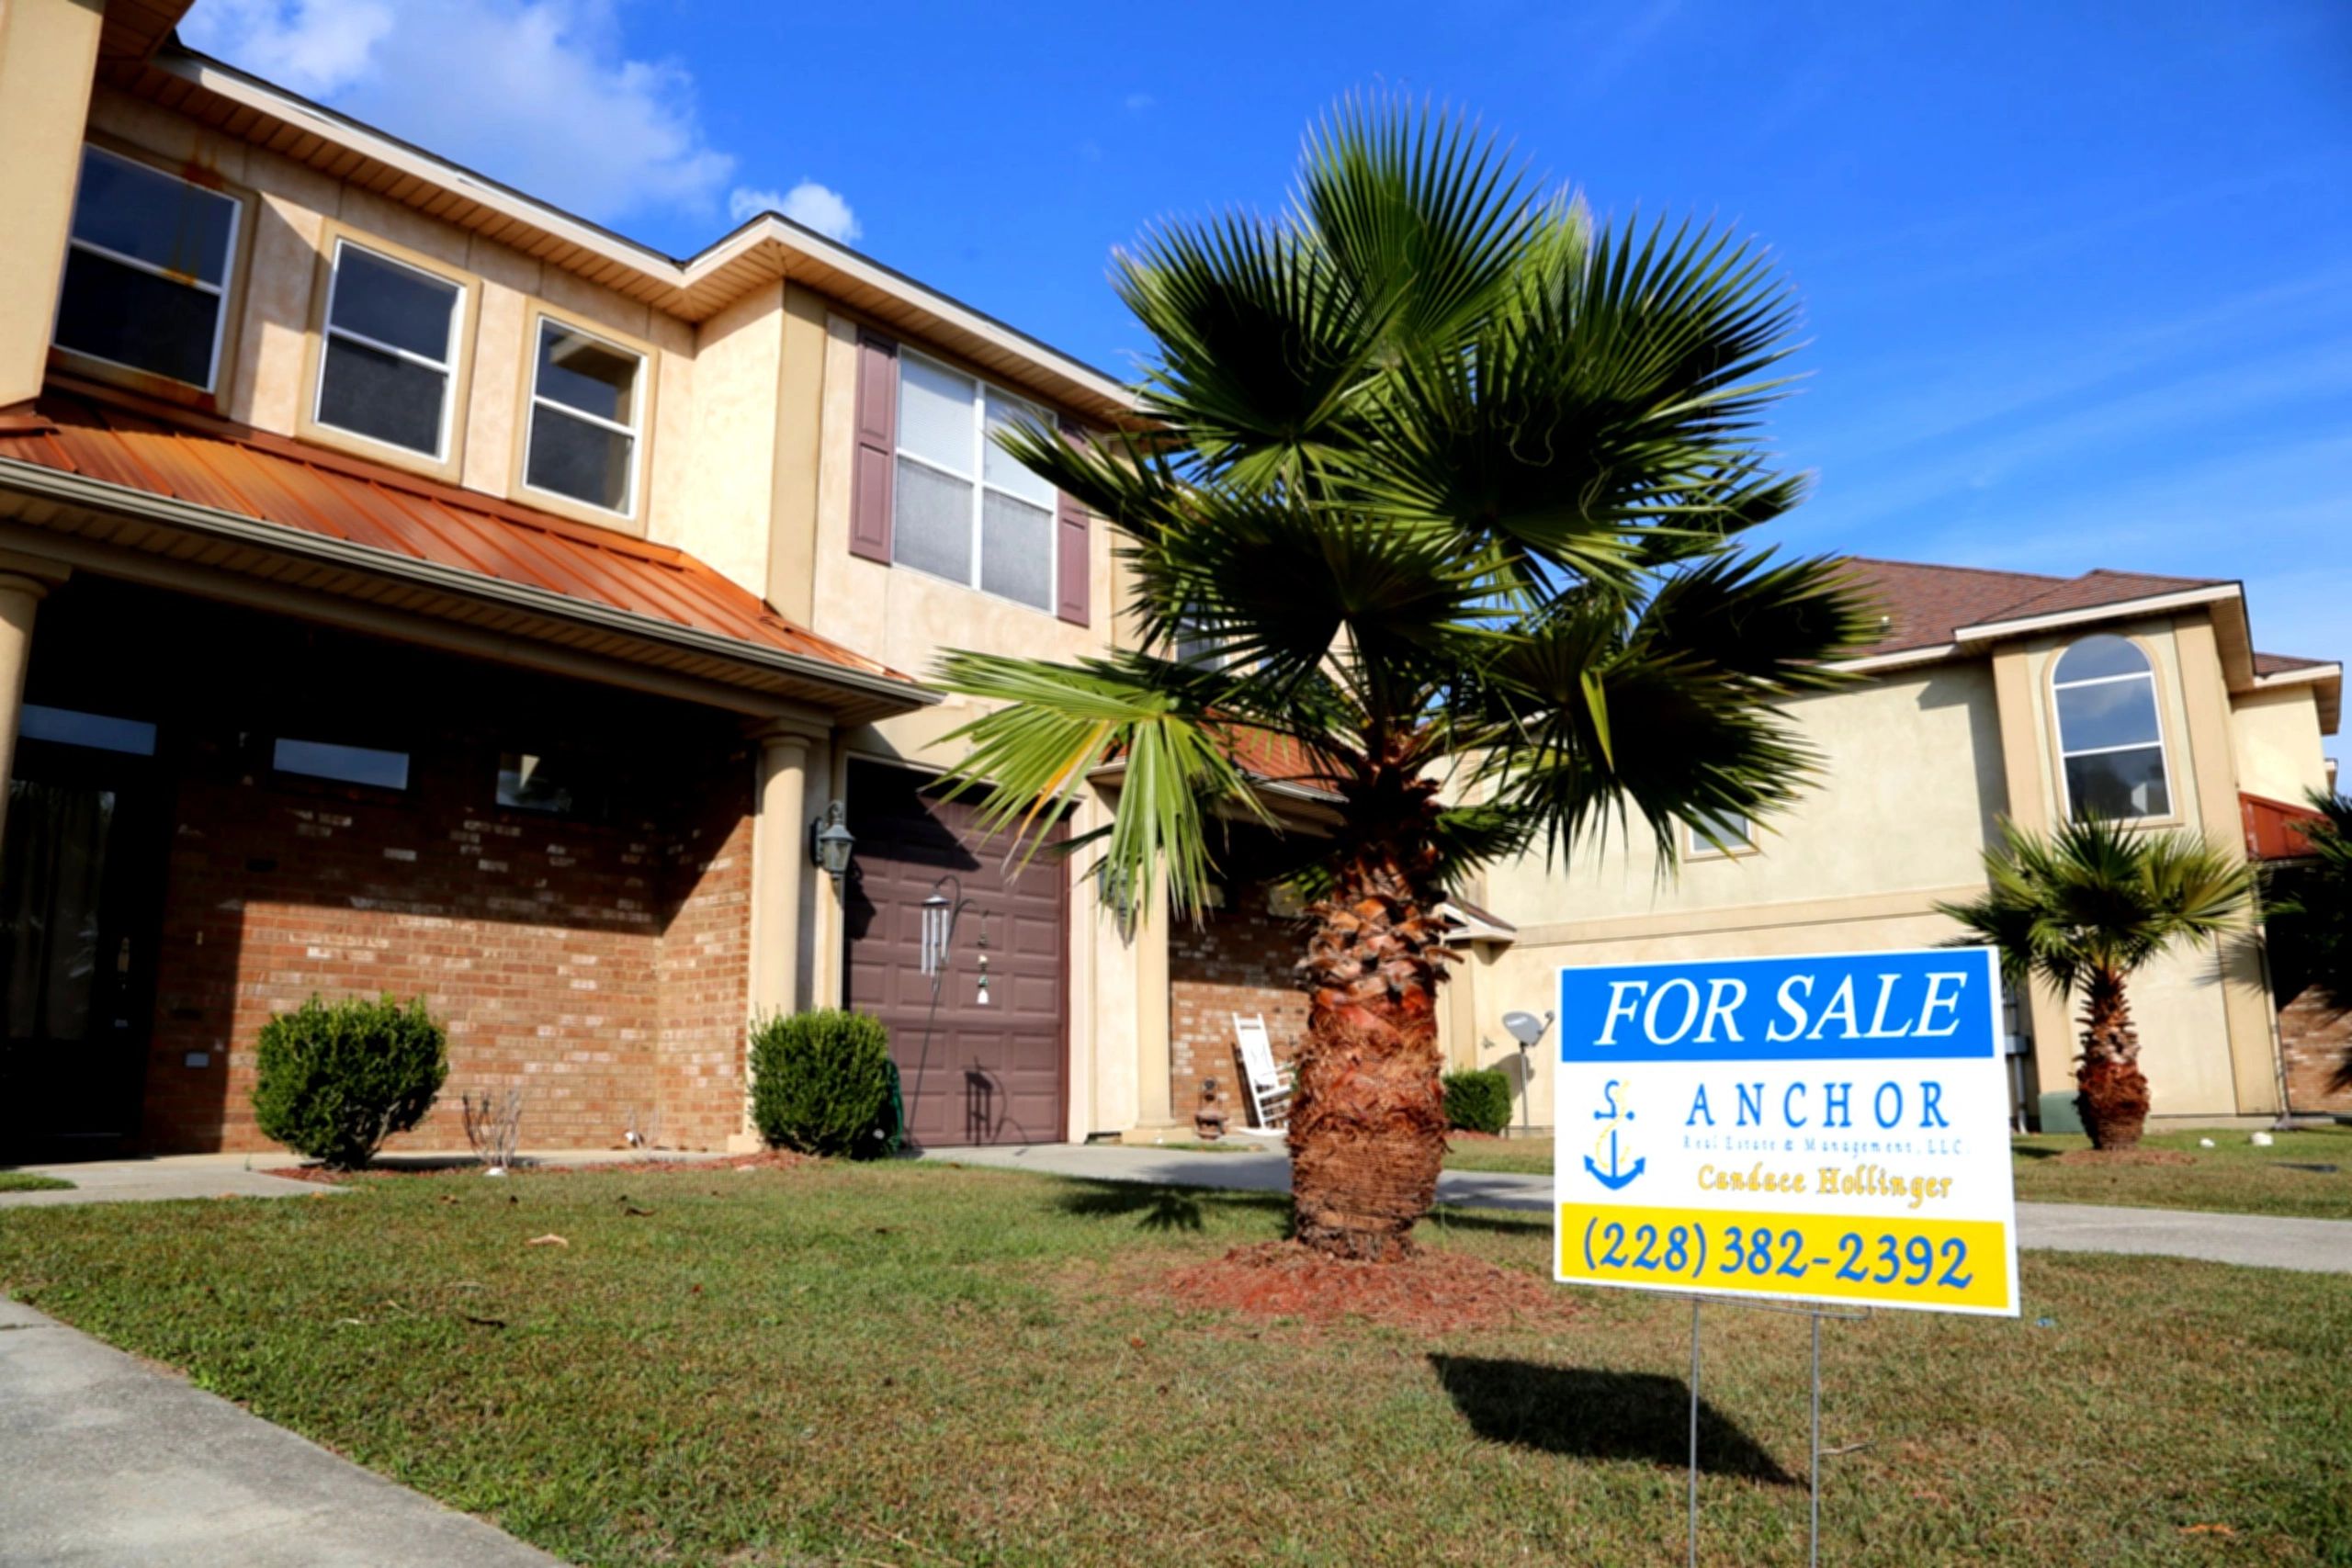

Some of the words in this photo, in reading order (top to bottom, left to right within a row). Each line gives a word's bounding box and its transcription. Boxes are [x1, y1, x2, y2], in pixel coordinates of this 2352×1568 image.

[1595, 977, 1747, 1045] FOR
[1766, 972, 1968, 1042] SALE
[1685, 1080, 1950, 1129] ANCHOR
[1698, 1161, 1806, 1193] Candace
[1816, 1163, 1953, 1210] Hollinger
[1583, 1217, 1707, 1278] (228)
[1719, 1225, 1973, 1290] 382-2392
